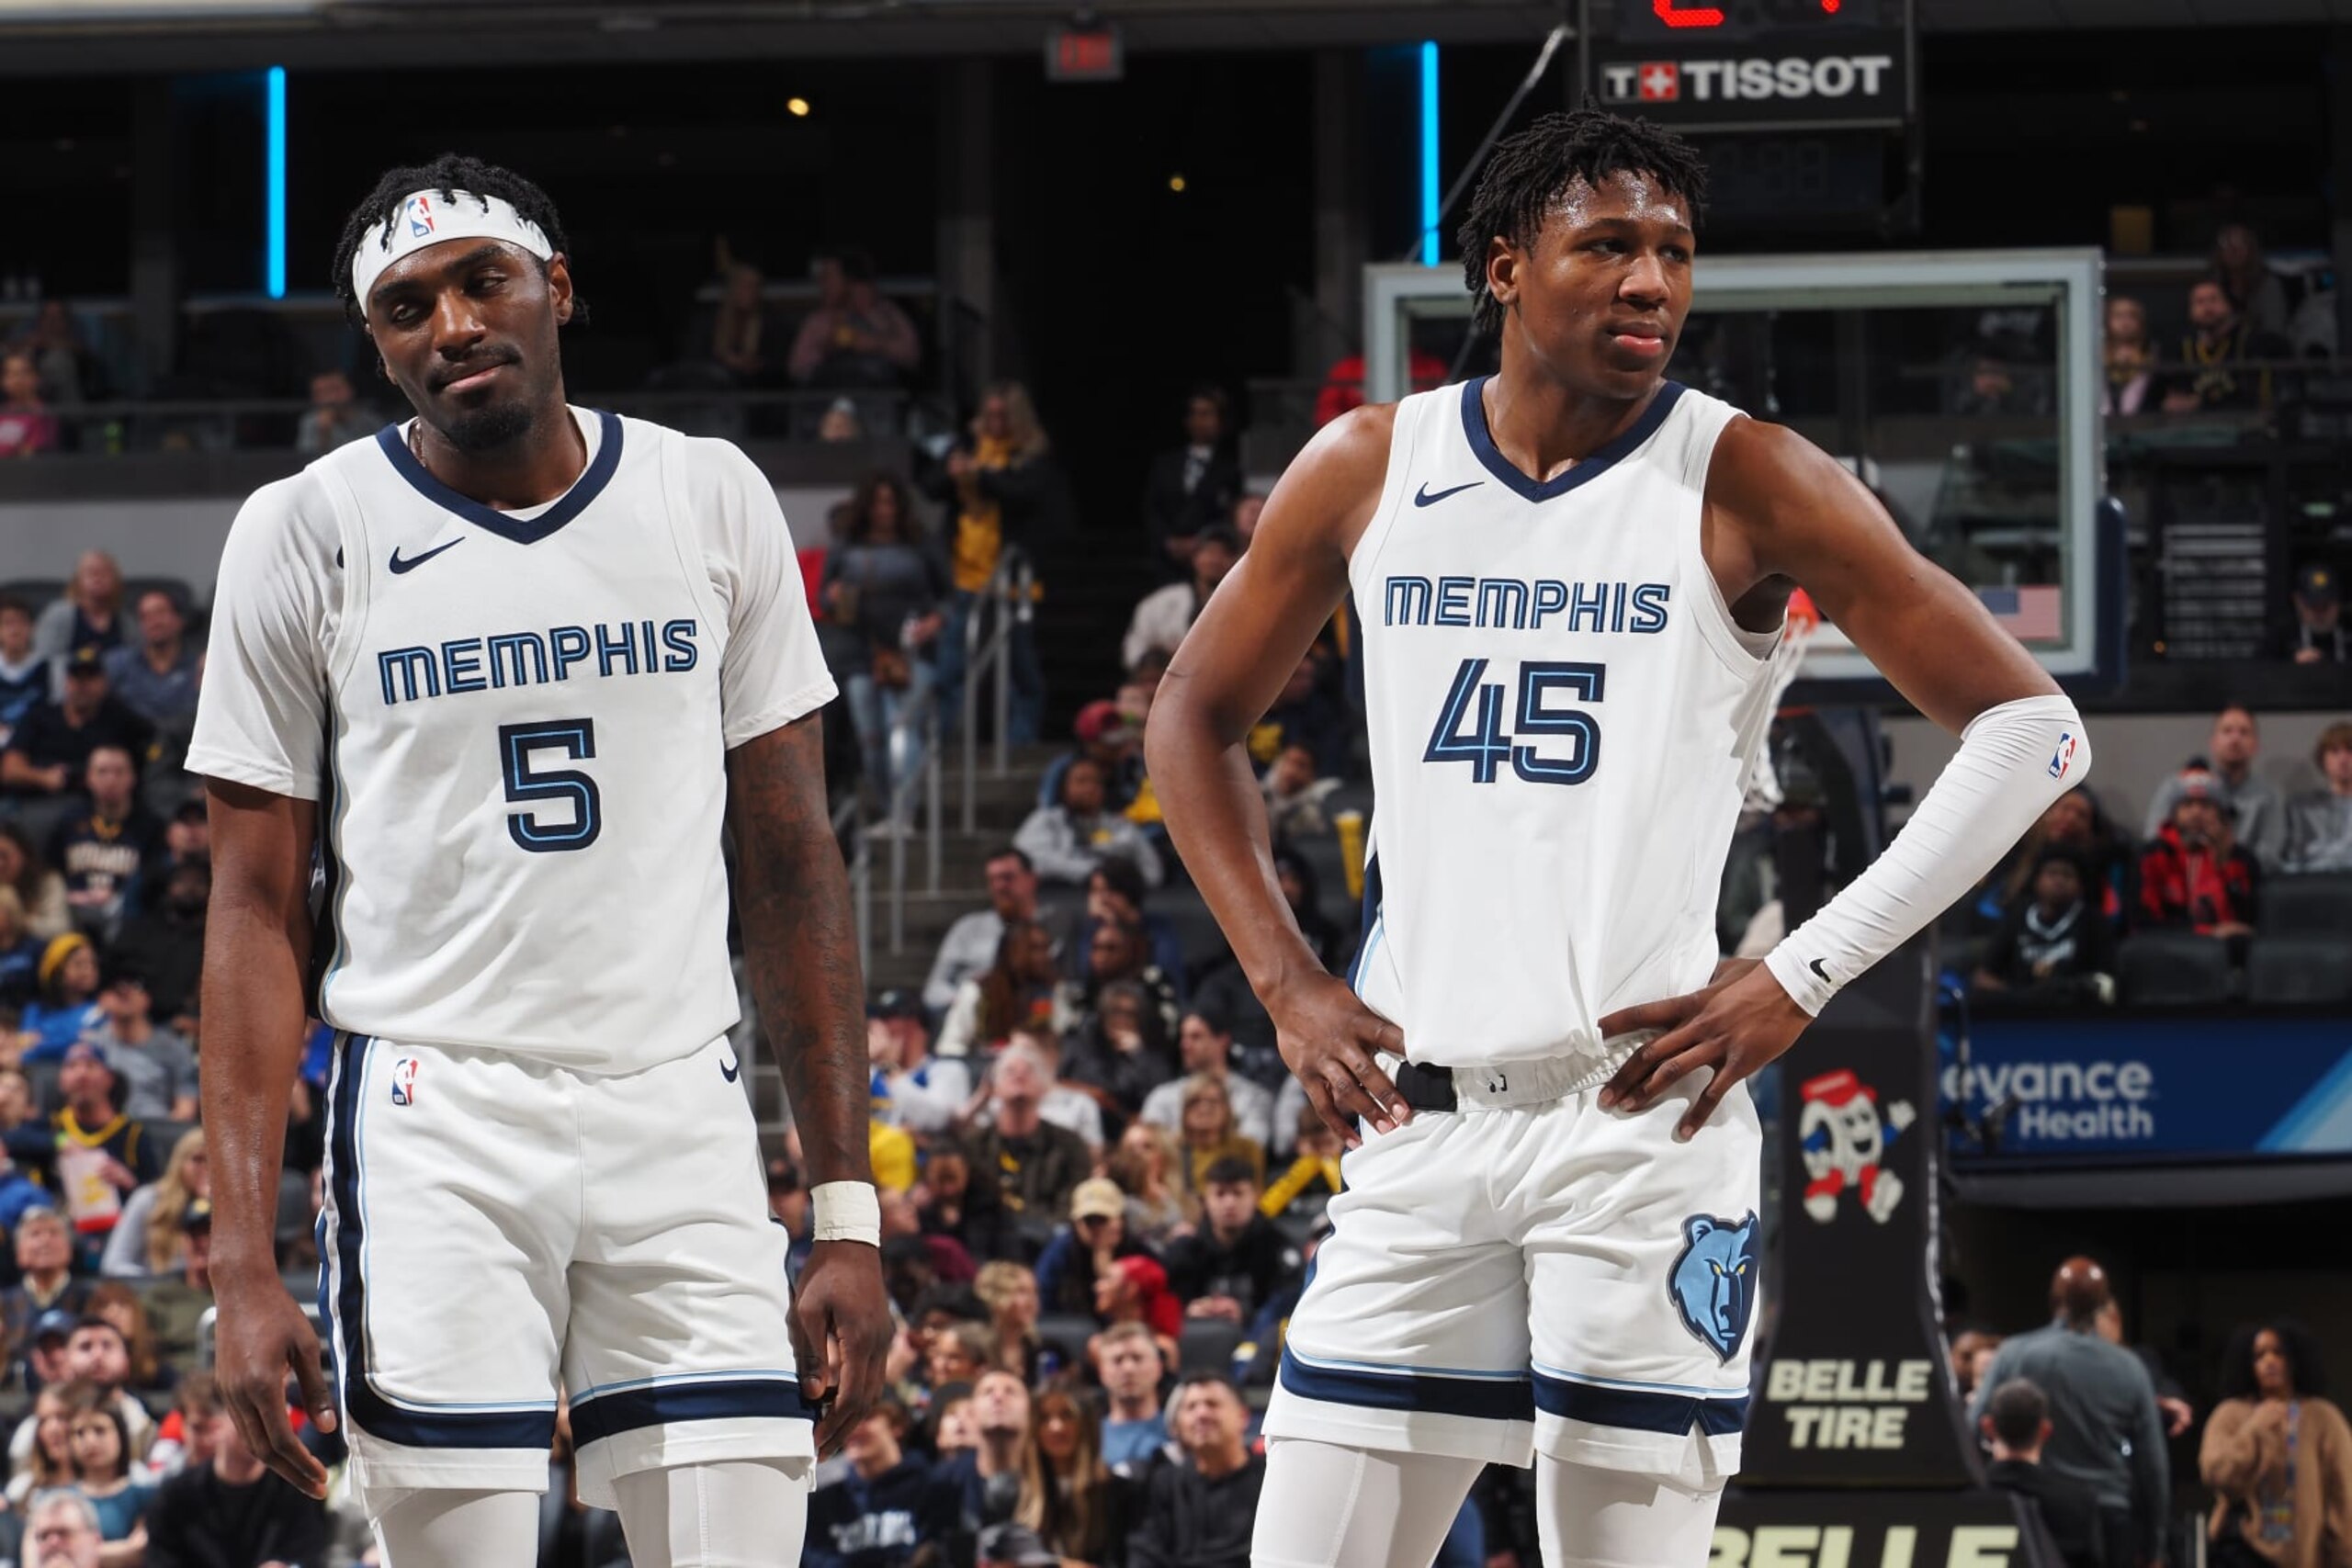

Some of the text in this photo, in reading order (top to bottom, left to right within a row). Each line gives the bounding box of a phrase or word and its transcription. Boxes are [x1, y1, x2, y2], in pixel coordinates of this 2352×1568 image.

[1682, 56, 1893, 100] TISSOT
[1385, 576, 1671, 634] MEMPHIS
[378, 619, 698, 705] MEMPHIS
[1422, 658, 1606, 785] 45
[498, 717, 602, 853] 5
[2021, 1102, 2154, 1138] Health
[1767, 1359, 1933, 1402] BELLE
[1784, 1406, 1908, 1449] TIRE
